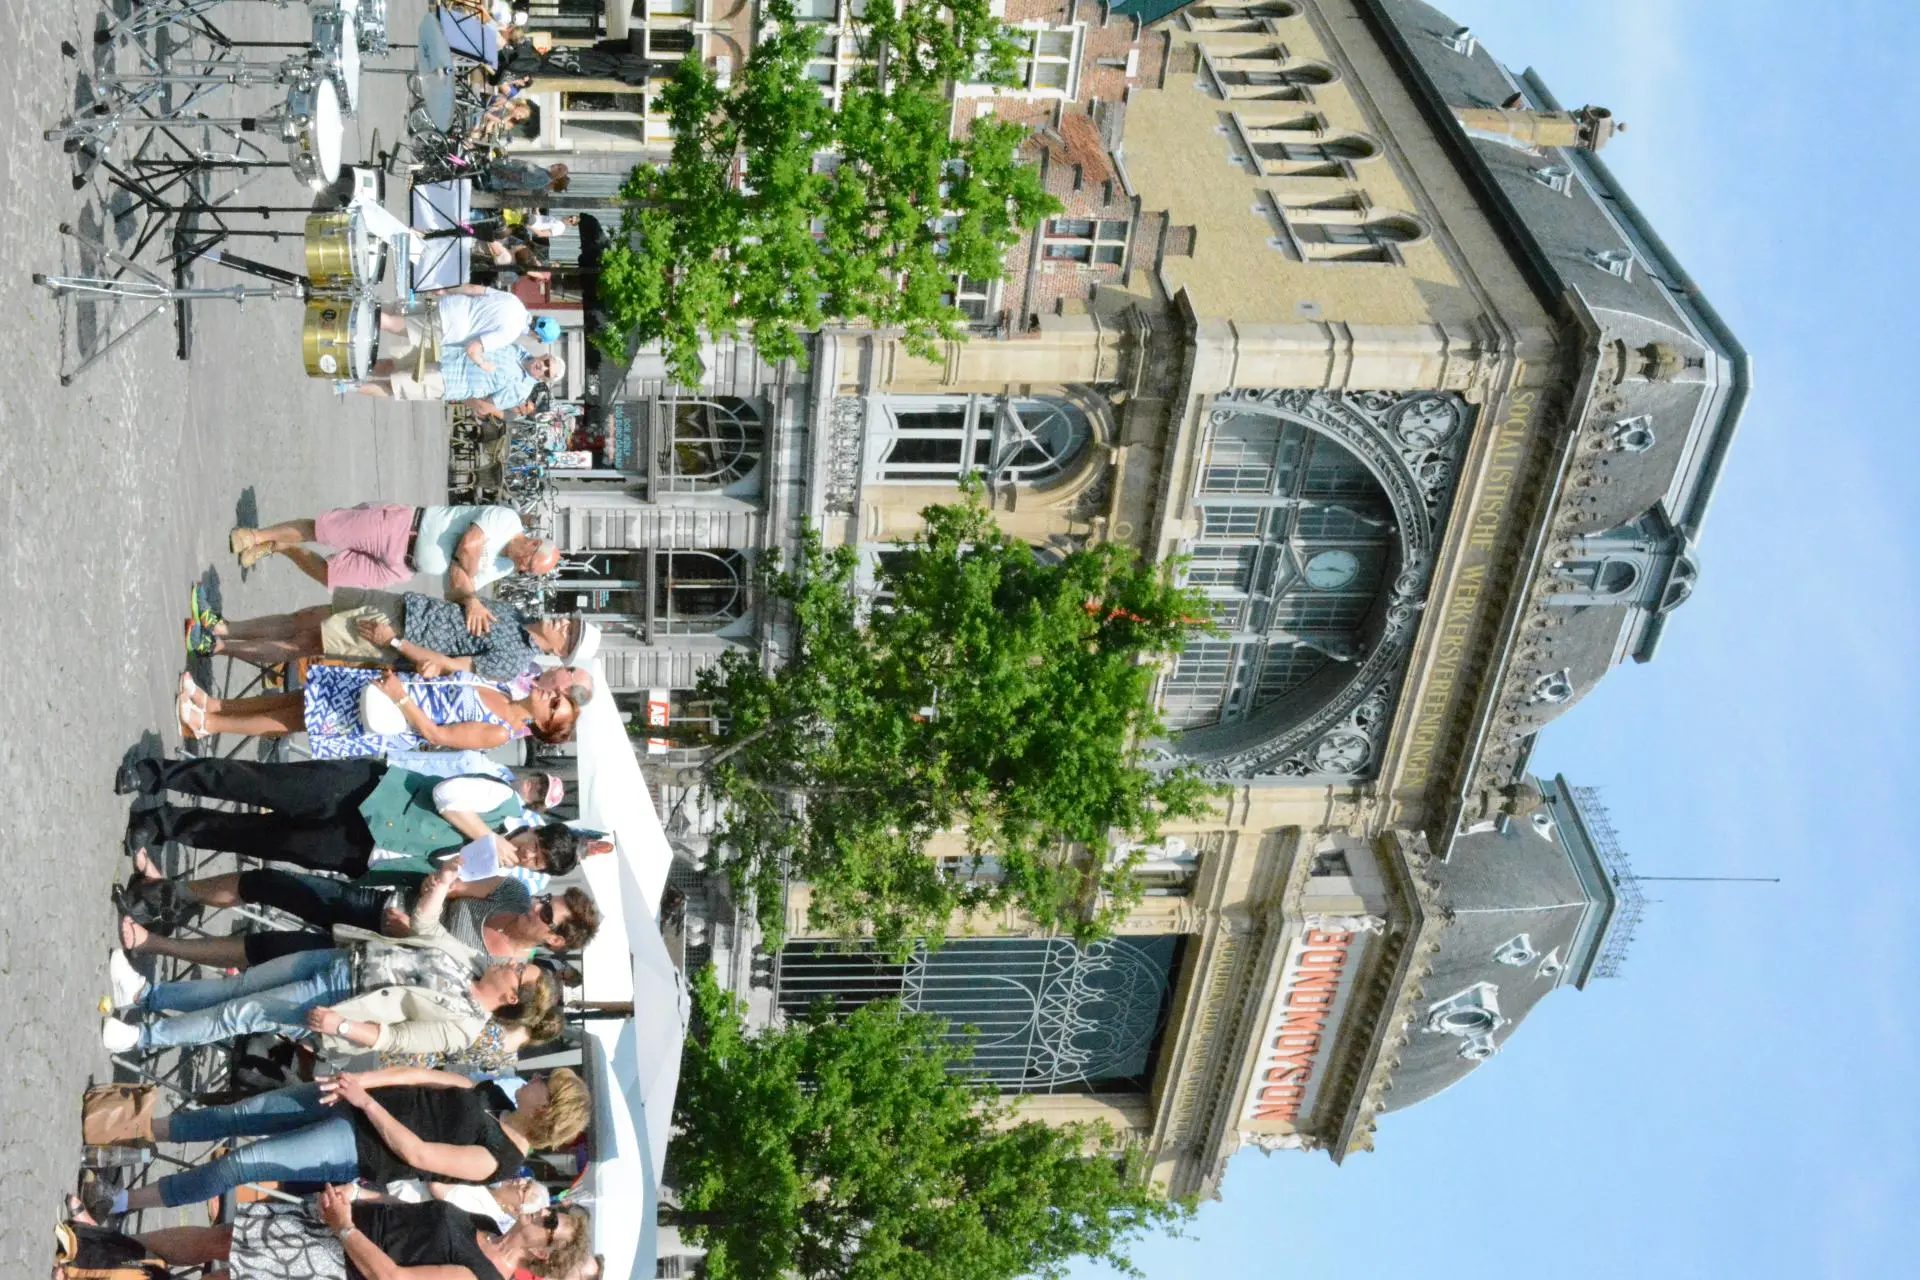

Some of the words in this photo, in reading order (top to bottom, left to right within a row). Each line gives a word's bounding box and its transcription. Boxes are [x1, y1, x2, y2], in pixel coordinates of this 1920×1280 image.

[1469, 391, 1536, 550] SOCIALISTISCHE
[1404, 563, 1486, 788] WERKERSVEREENIGINGEN
[1251, 930, 1355, 1121] BONDMOYSON
